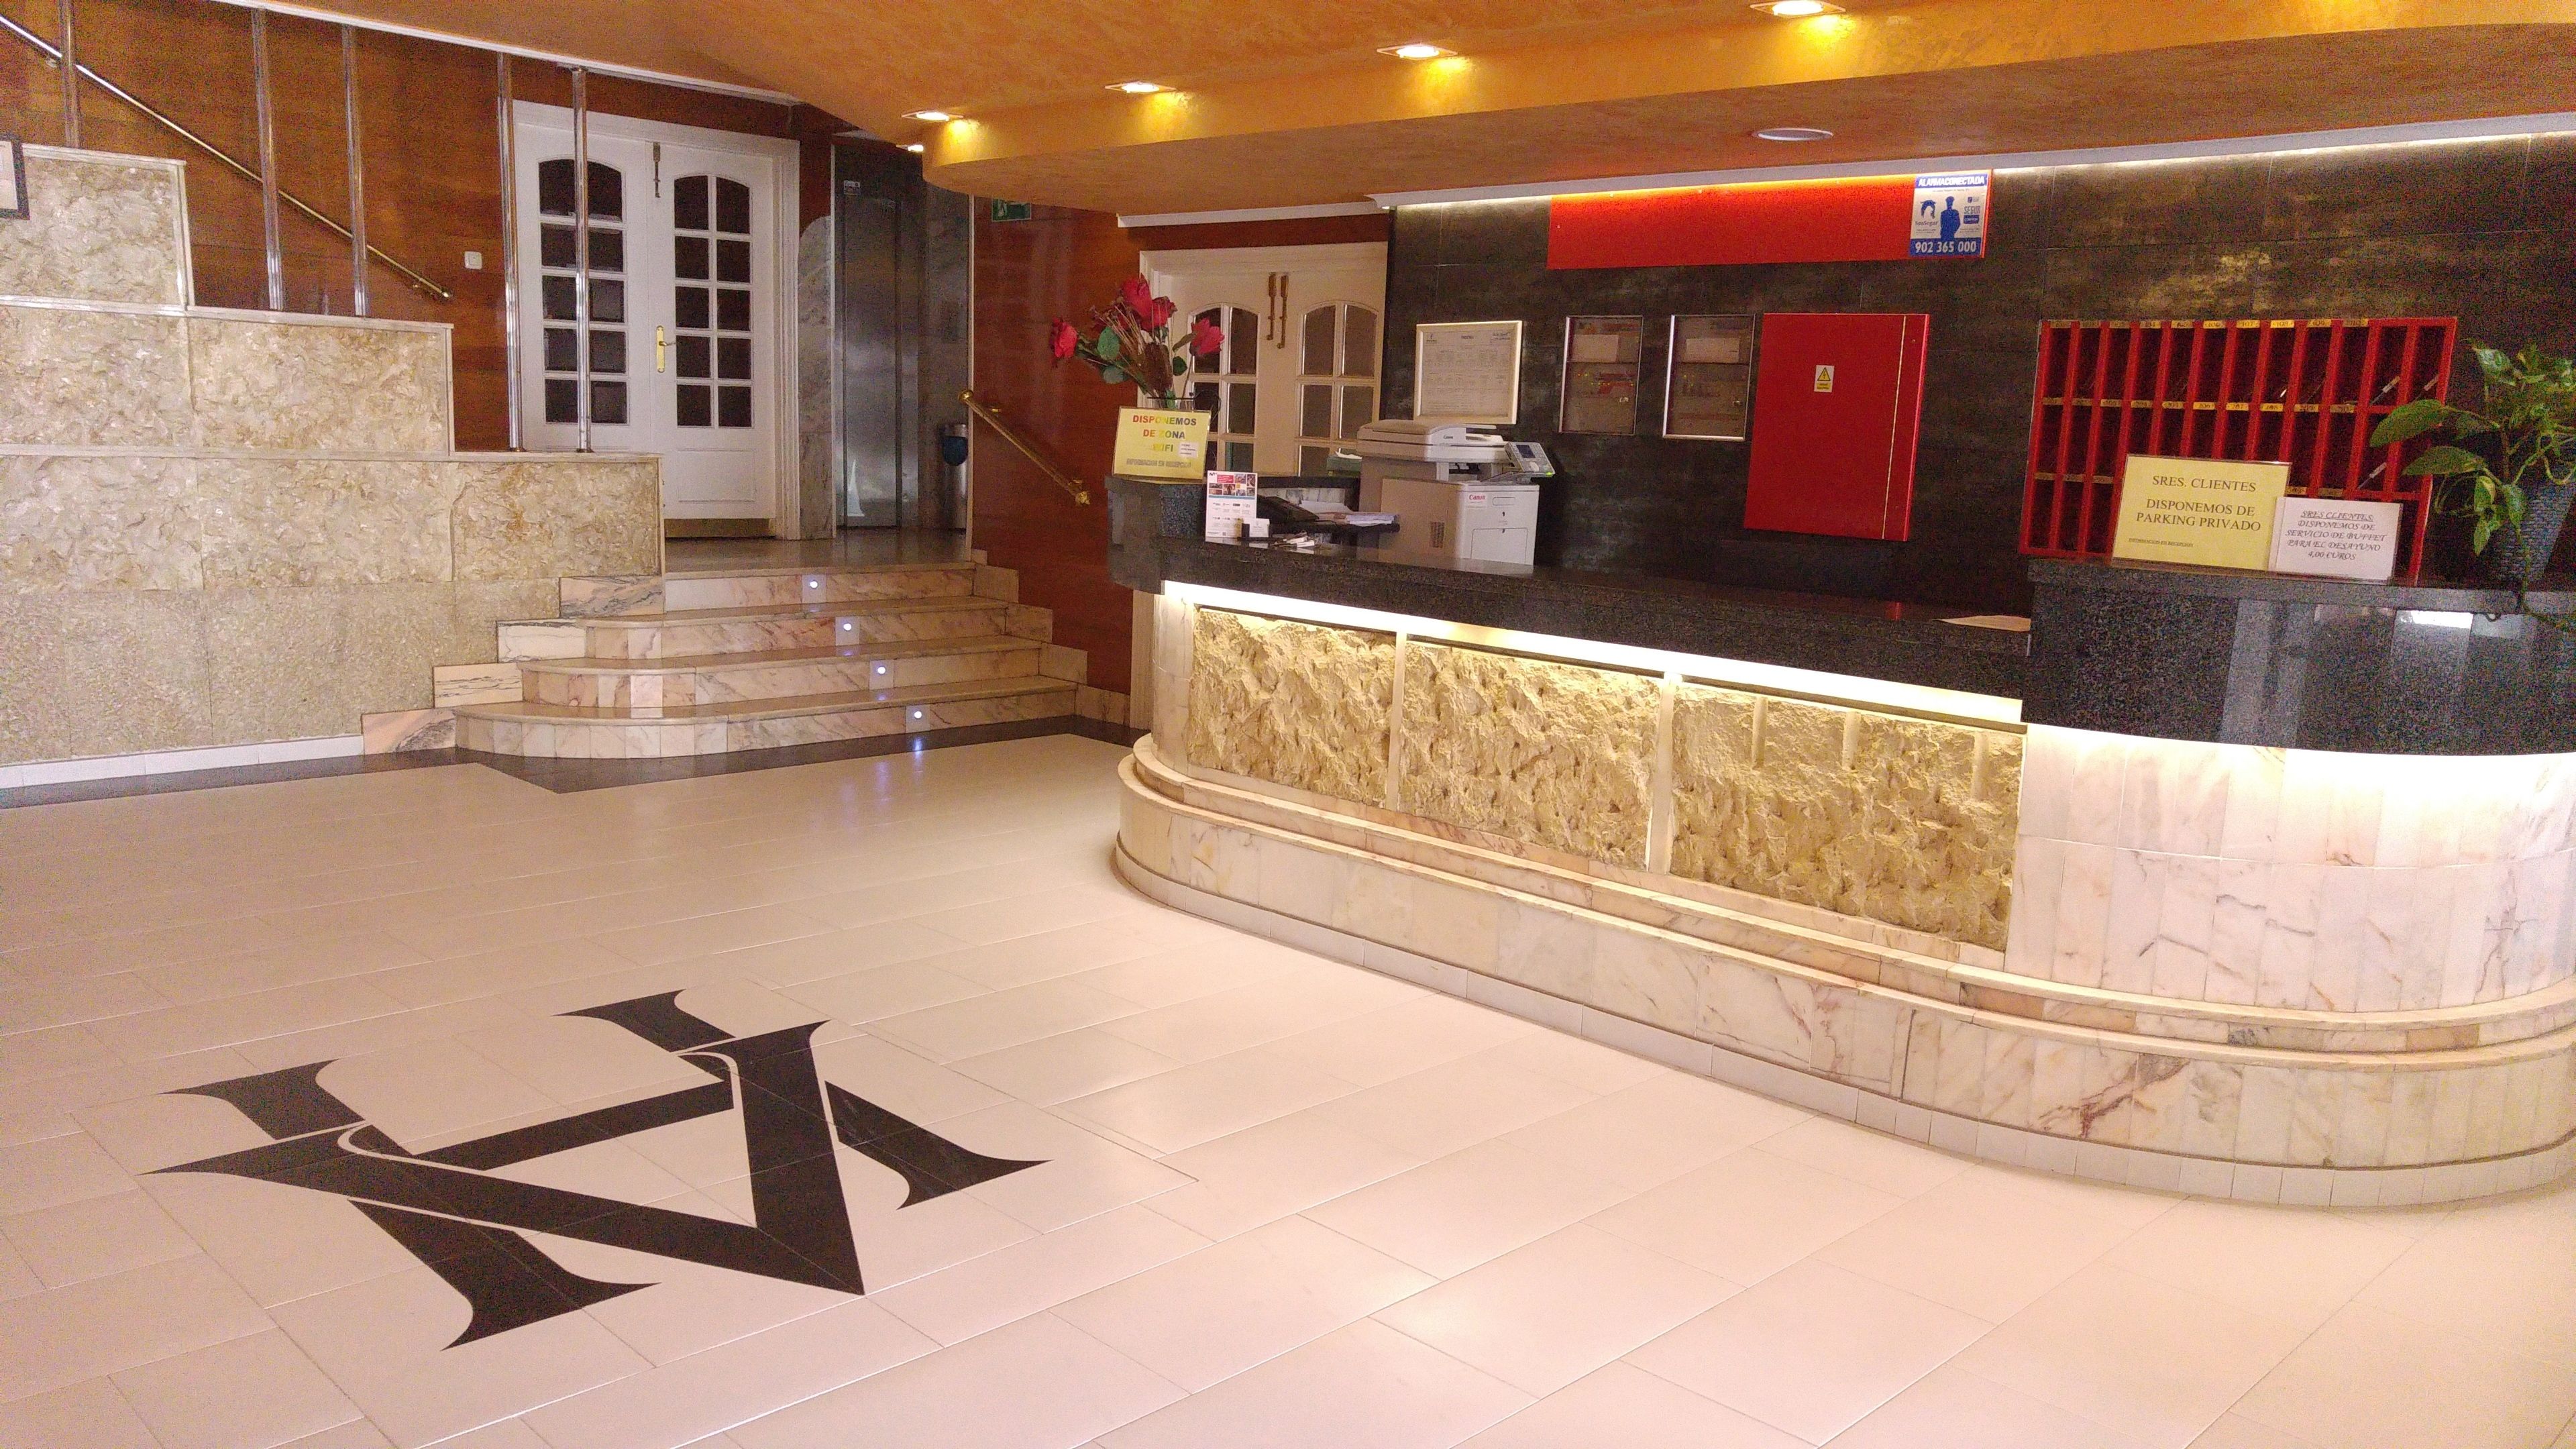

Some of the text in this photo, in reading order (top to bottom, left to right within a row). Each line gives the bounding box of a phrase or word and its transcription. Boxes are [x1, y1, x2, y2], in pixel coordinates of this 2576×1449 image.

[1915, 241, 1976, 253] 902 365 000
[1133, 415, 1197, 426] DISPONEMOS
[1143, 429, 1185, 439] DE ZONA
[2152, 475, 2257, 492] SRES. CLIENTES
[2147, 498, 2255, 517] DISPONEMOS DE
[2301, 510, 2324, 518] SRES
[2137, 512, 2261, 531] PARKING PRIVADO
[2298, 520, 2360, 530] DISPONEMOS
[2285, 529, 2329, 538] SERVICIO
[2347, 533, 2387, 541] BUFFET
[2287, 539, 2312, 547] PARA
[2328, 541, 2381, 551] DESAYUNO
[2326, 552, 2357, 560] EUROS
